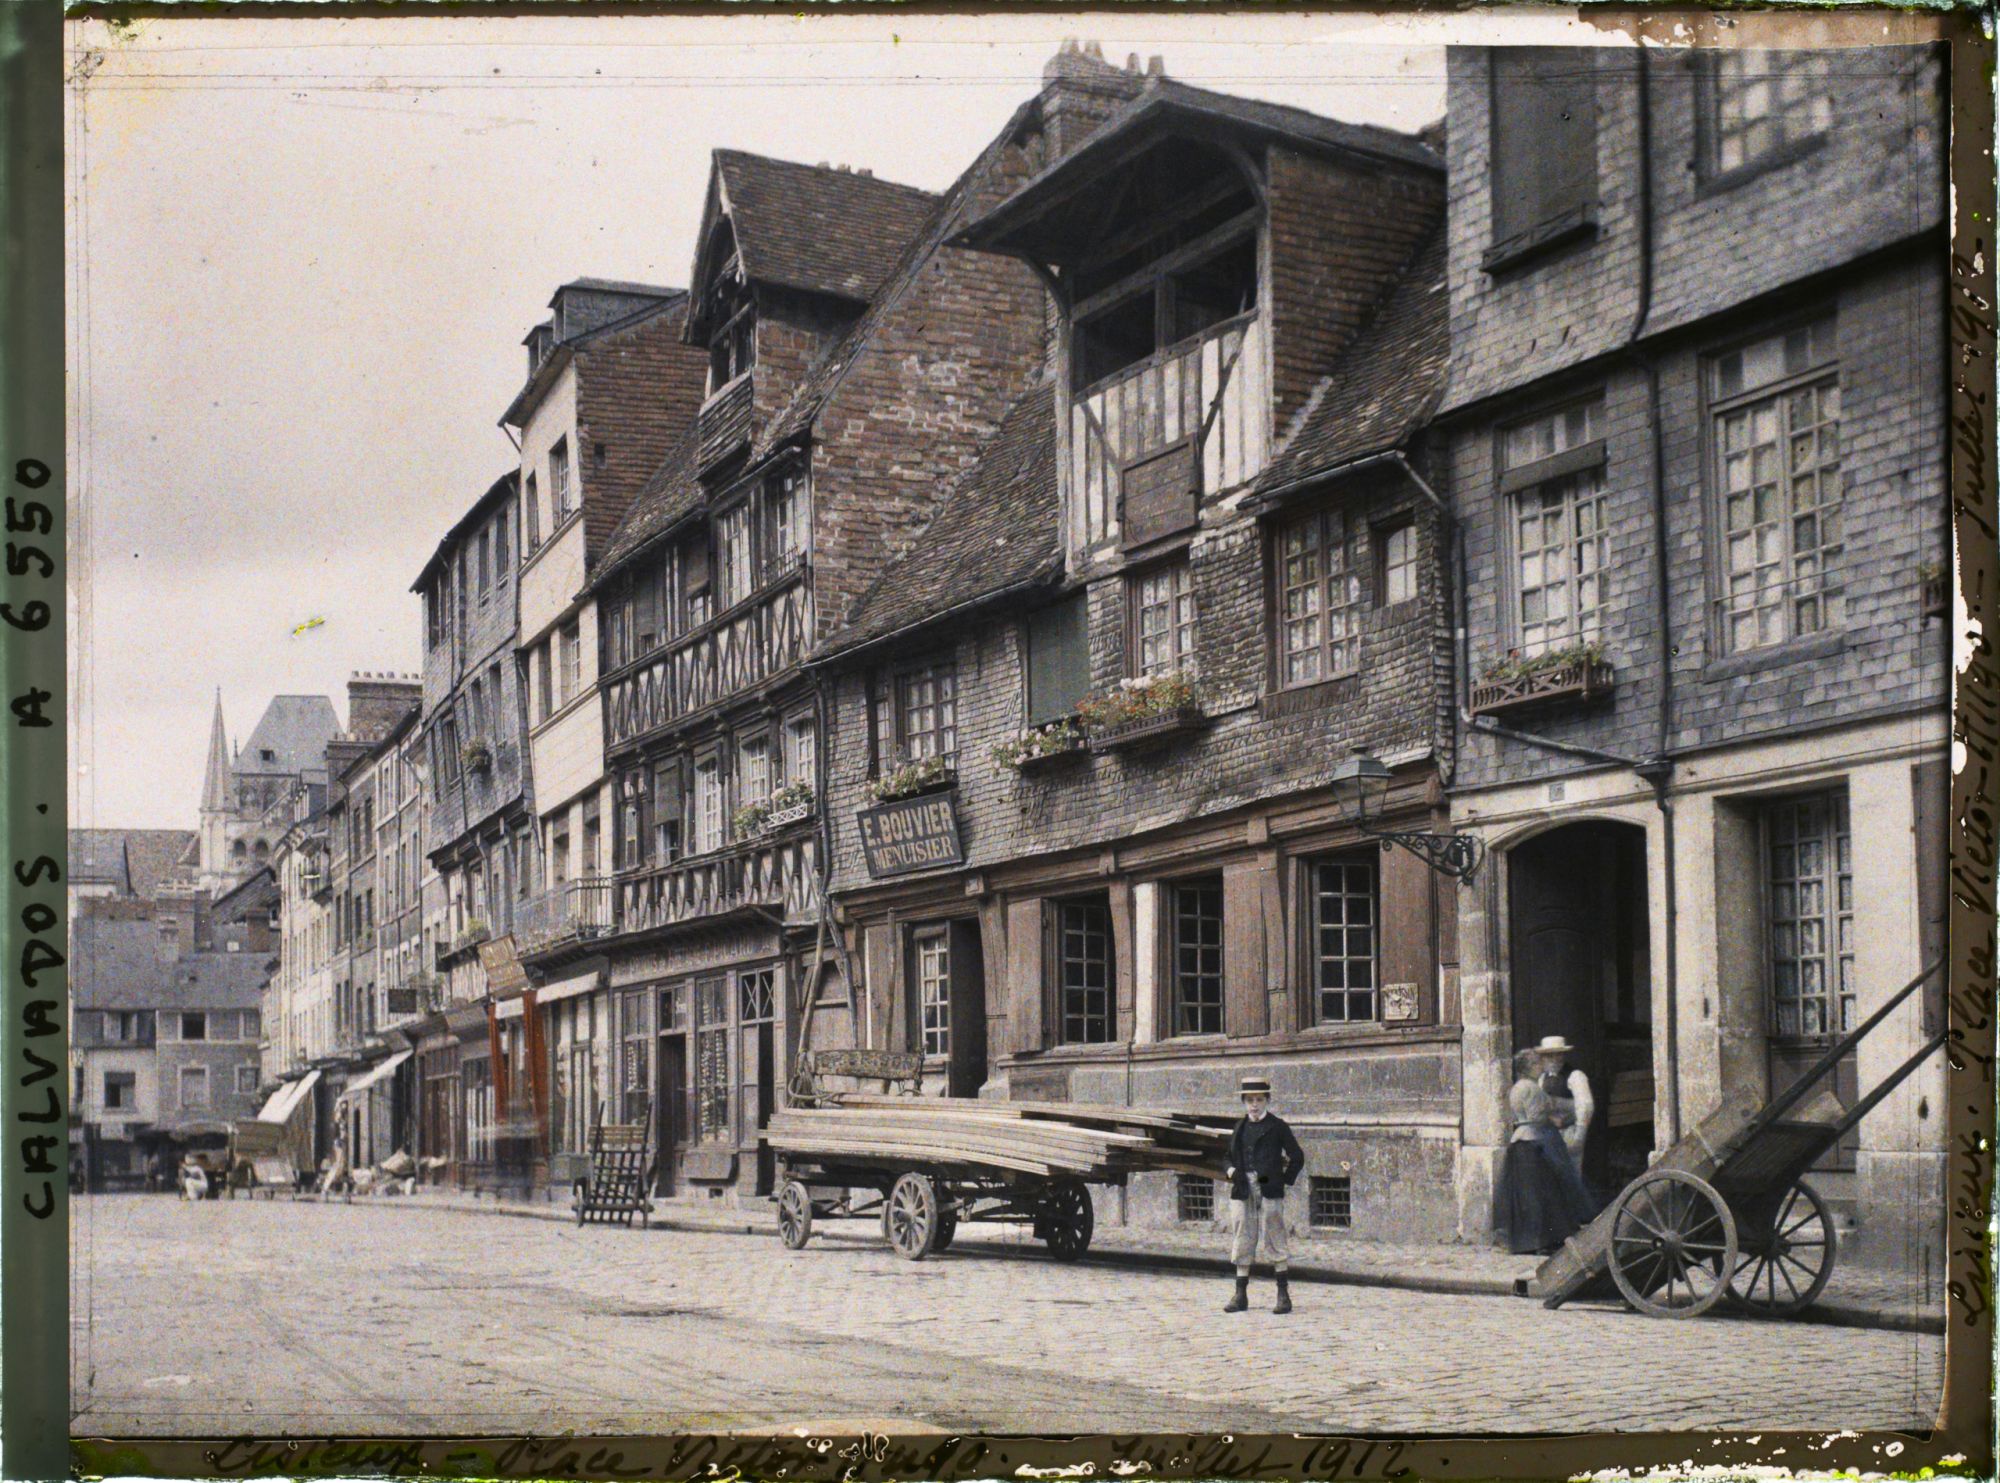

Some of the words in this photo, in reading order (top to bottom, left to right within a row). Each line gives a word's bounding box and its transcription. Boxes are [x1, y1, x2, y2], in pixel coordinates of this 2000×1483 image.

[1951, 380, 1996, 540] Juillet
[0, 458, 54, 632] 6550
[10, 686, 53, 729] A
[878, 801, 954, 844] BOUVIER
[872, 836, 955, 869] MENUISIER
[1946, 926, 1996, 1082] Place
[494, 1436, 652, 1476] Place
